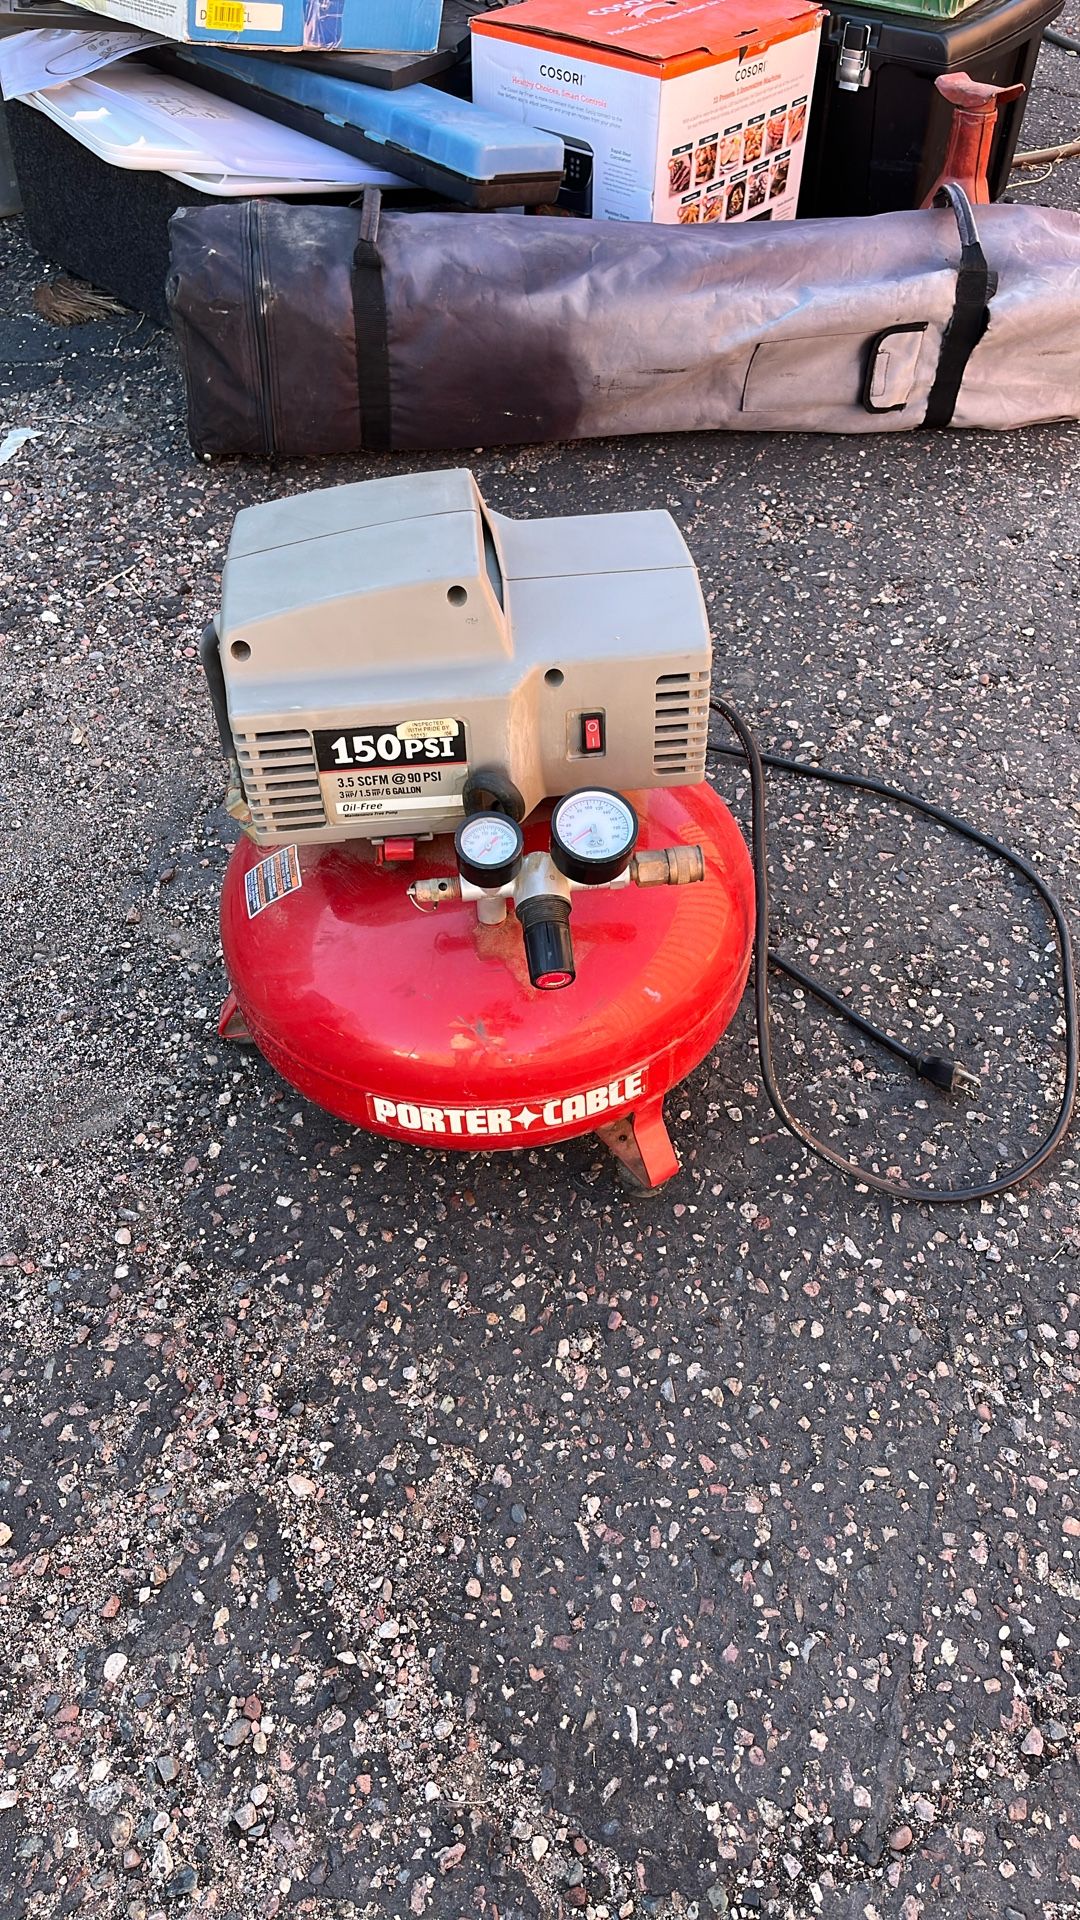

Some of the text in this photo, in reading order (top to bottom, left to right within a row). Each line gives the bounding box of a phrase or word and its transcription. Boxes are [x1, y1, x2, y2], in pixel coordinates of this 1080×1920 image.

[539, 64, 583, 86] COSORI
[734, 61, 767, 82] COSORI
[511, 76, 536, 91] Healthy
[331, 733, 455, 765] 150 PSI
[337, 777, 355, 788] 3.5
[357, 774, 389, 787] SCFM
[423, 771, 442, 782] PSI
[392, 786, 422, 795] GALLON
[342, 802, 383, 812] Oil-Free
[373, 1071, 643, 1134] PORTER CABLE
